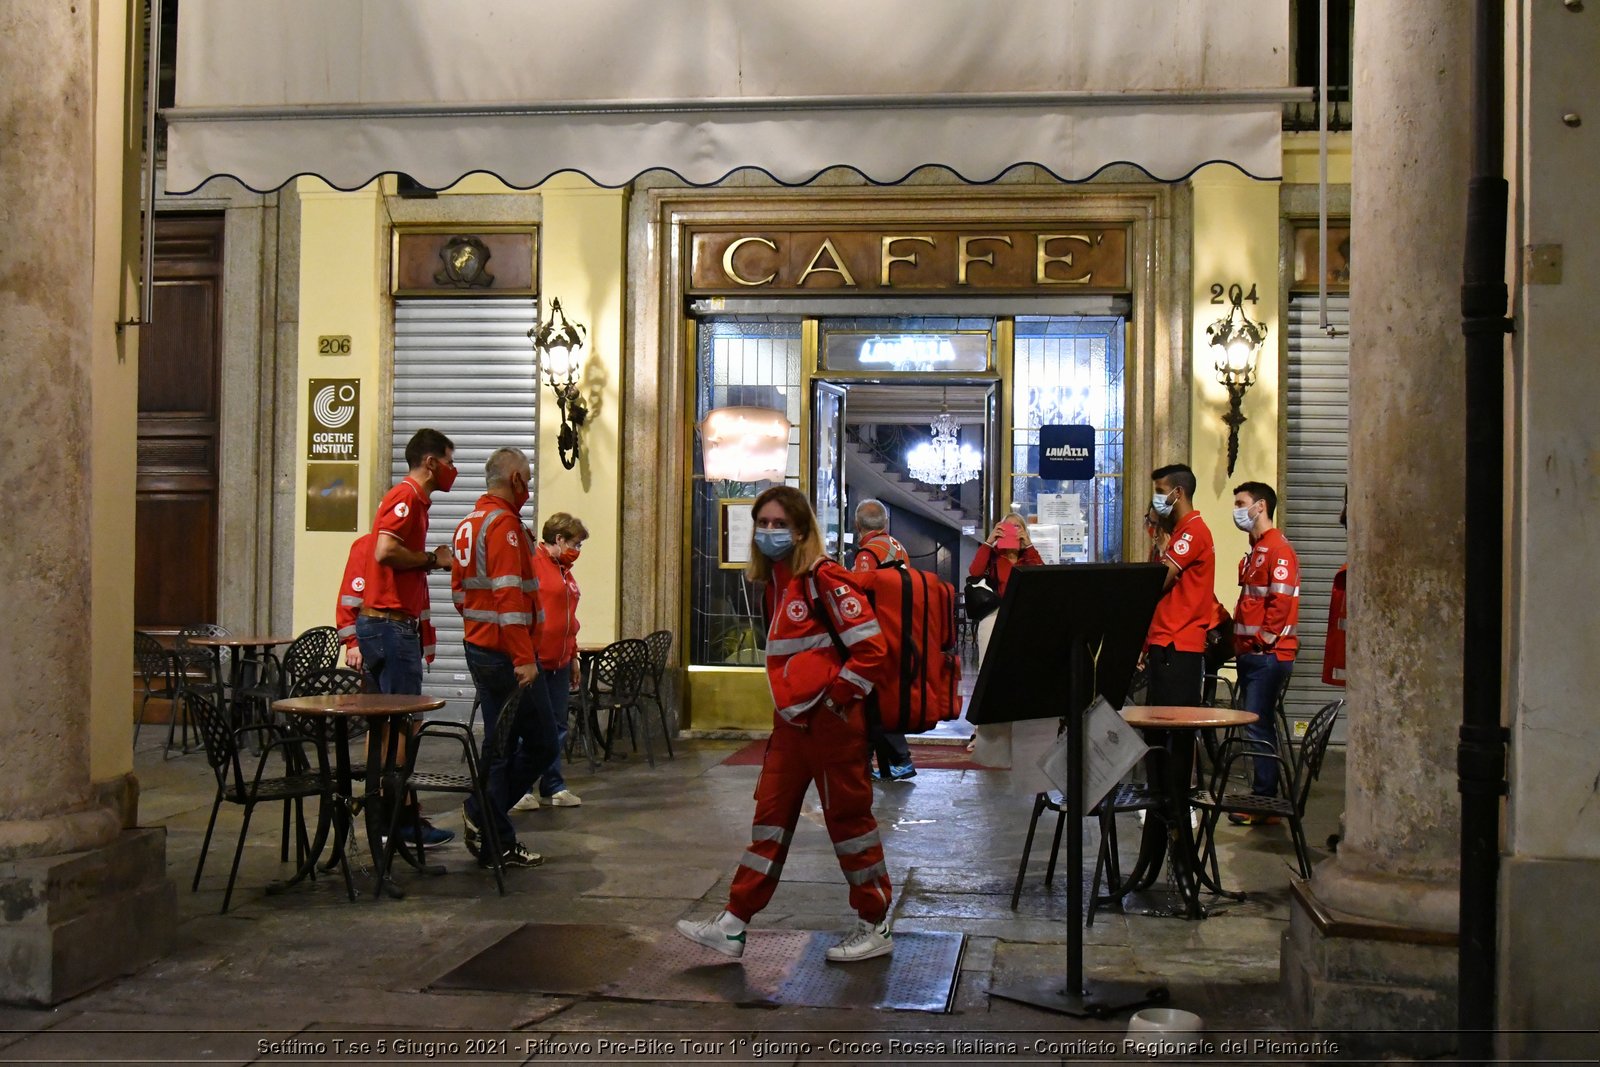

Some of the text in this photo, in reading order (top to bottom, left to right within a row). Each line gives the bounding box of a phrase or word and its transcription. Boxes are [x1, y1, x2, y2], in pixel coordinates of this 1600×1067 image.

[1210, 284, 1260, 306] 204
[319, 338, 351, 354] 206
[313, 432, 354, 443] GOETHE
[313, 444, 353, 454] INSTITUT
[1045, 444, 1089, 457] LAVAZZA
